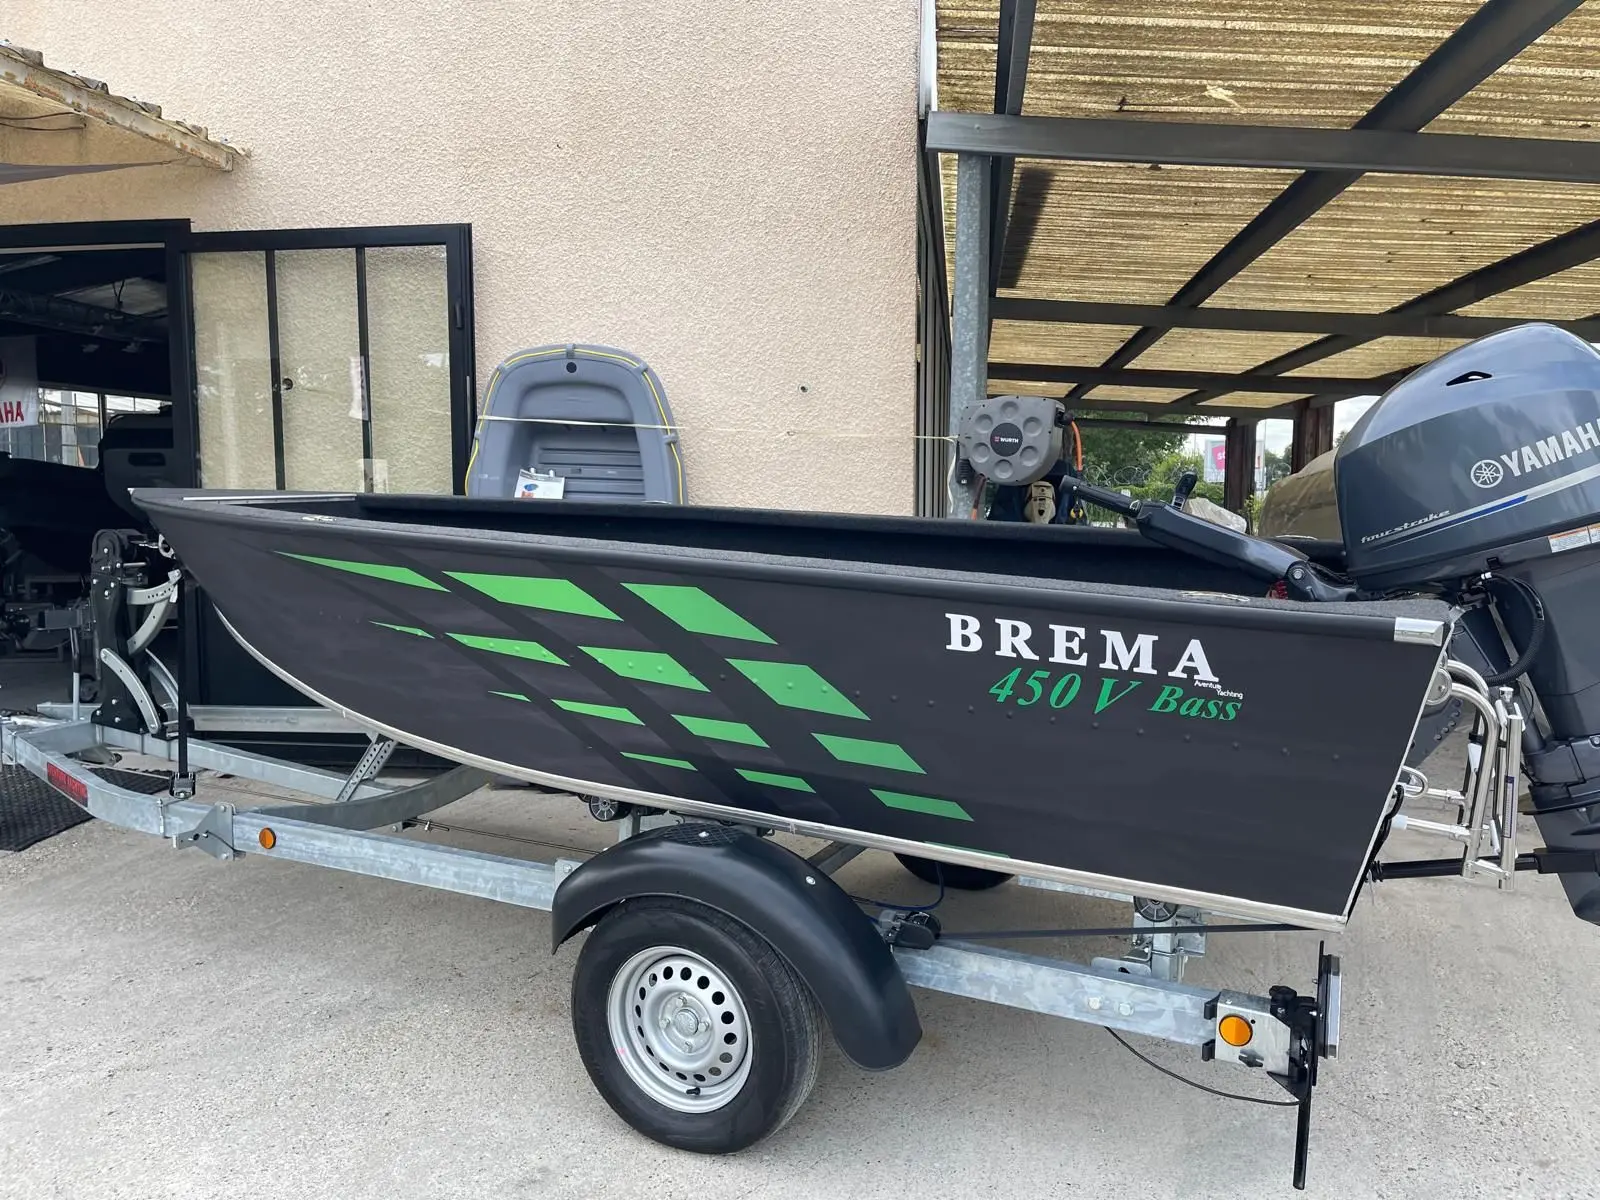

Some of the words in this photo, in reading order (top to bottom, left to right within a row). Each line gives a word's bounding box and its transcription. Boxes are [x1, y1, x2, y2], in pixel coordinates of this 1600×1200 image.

[1500, 418, 1600, 477] YAMAH
[945, 613, 1219, 682] BREMA
[989, 667, 1082, 709] 450
[1094, 677, 1142, 714] V
[1147, 685, 1242, 721] Bass
